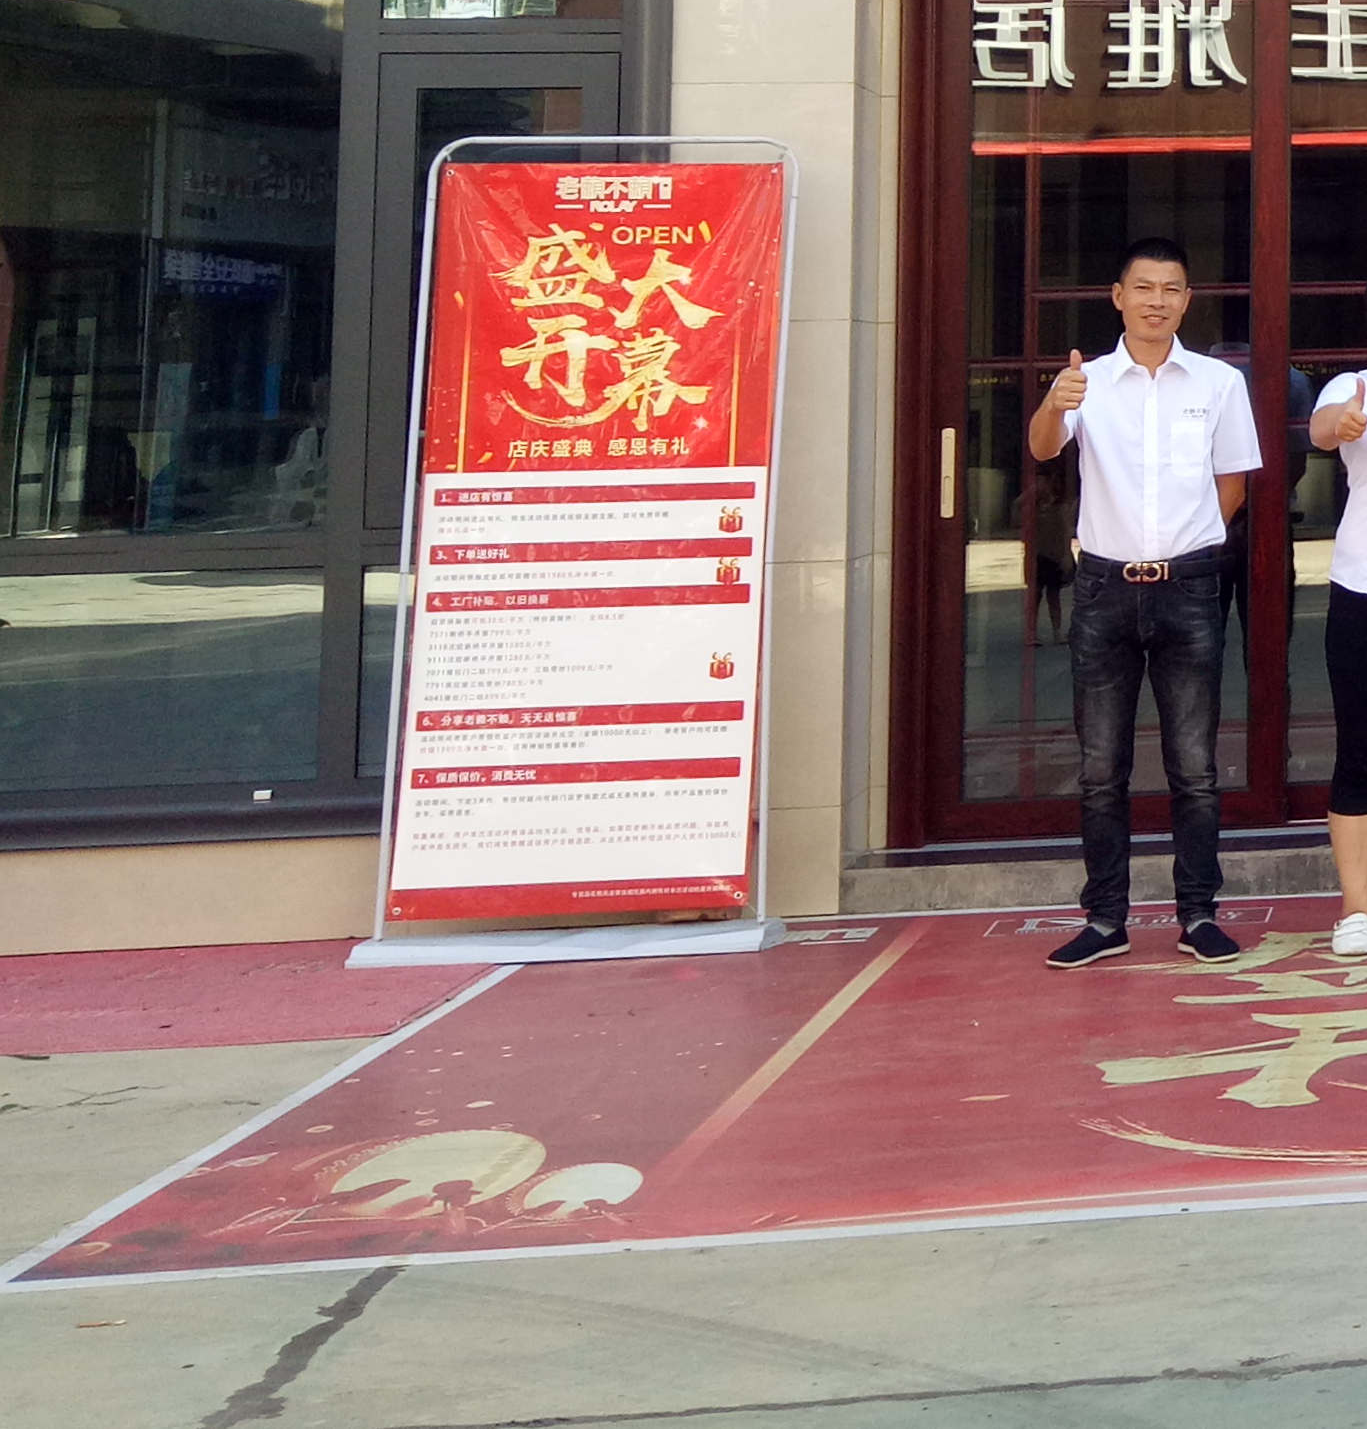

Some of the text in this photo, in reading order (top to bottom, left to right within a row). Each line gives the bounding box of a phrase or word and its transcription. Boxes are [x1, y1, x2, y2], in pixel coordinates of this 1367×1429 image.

[611, 225, 694, 246] OPEN
[507, 437, 690, 459] 店庆盛典 感恩有礼
